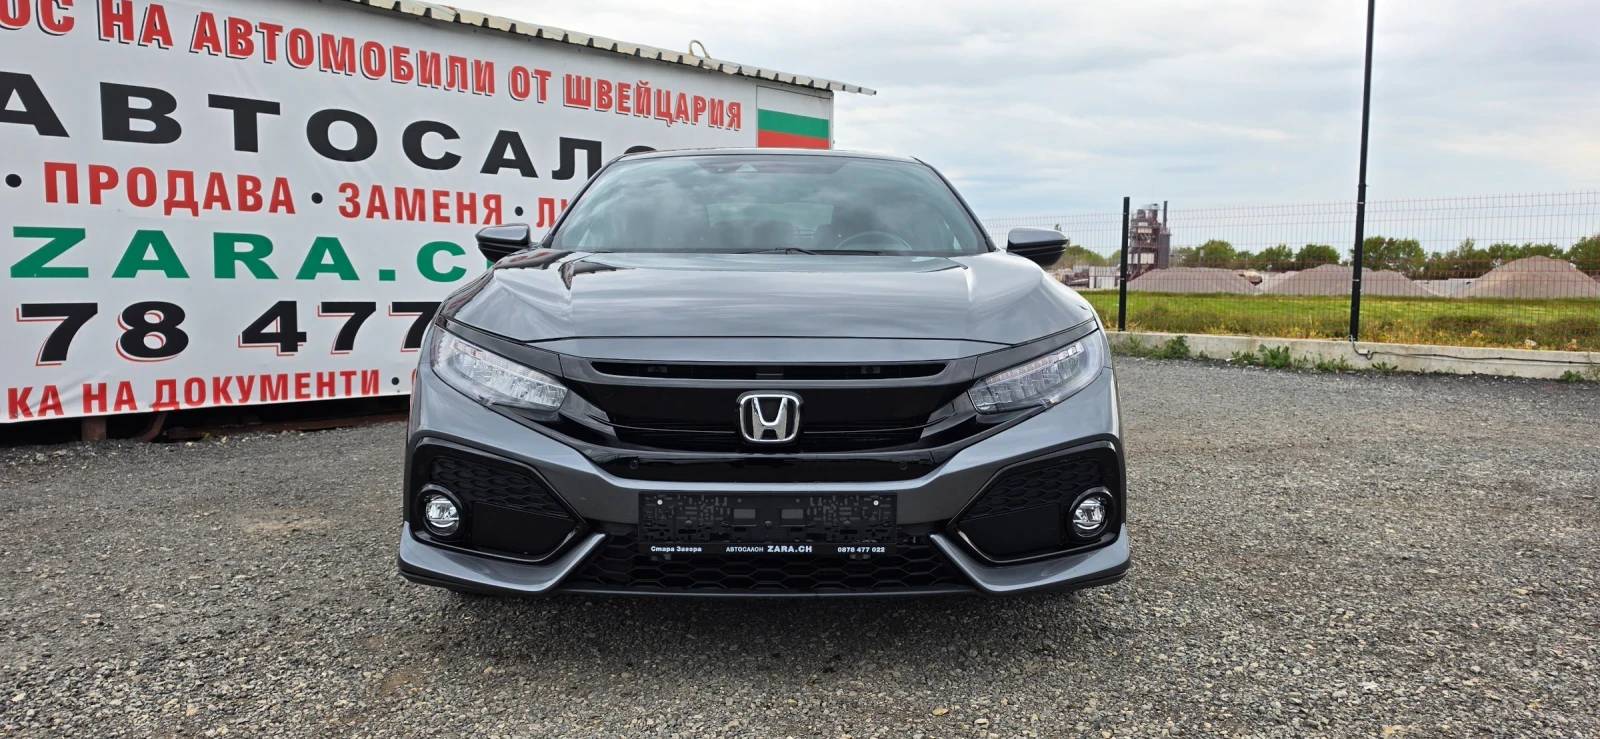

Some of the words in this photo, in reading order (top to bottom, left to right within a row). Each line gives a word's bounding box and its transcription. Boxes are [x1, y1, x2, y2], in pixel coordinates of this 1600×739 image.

[97, 0, 174, 48] НА
[189, 12, 496, 96] АВТОМОБИЛИ
[509, 65, 552, 102] ОТ
[563, 73, 742, 132] ШВЕЙЦАРИЯ
[0, 71, 657, 180] АВТОСАЛ
[44, 161, 296, 217] ПРОДАВА
[338, 182, 502, 225] ЗАМЕНЯ
[10, 226, 497, 283] ZARA.C
[16, 300, 189, 366] 78
[238, 300, 442, 357] 477
[8, 385, 64, 419] КА
[82, 381, 138, 413] НА
[152, 369, 380, 413] ДОКУМЕНТИ
[767, 545, 813, 553] ZARA.CH
